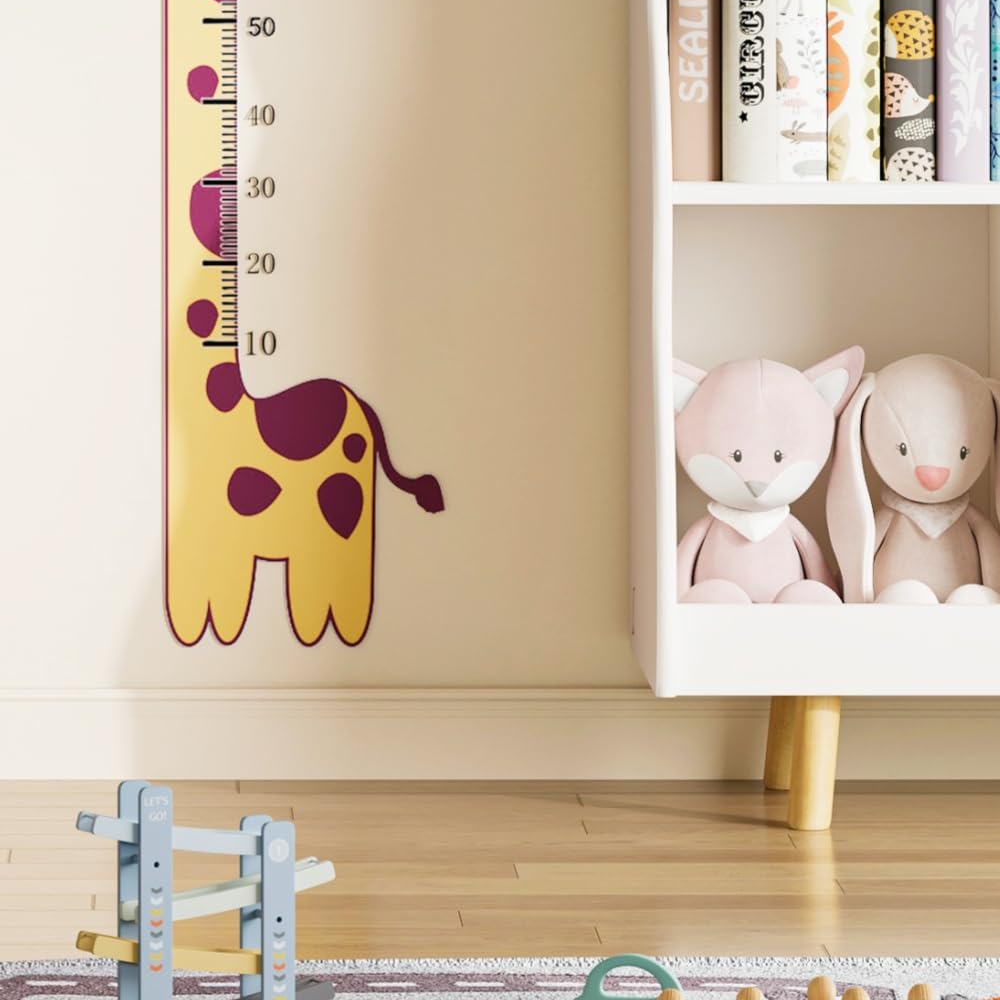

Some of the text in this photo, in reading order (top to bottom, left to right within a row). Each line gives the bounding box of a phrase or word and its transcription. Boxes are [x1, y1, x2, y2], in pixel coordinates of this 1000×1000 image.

[247, 17, 276, 37] 50
[245, 104, 276, 127] 40
[246, 176, 276, 199] 30
[246, 253, 276, 275] 20
[245, 331, 277, 357] 10
